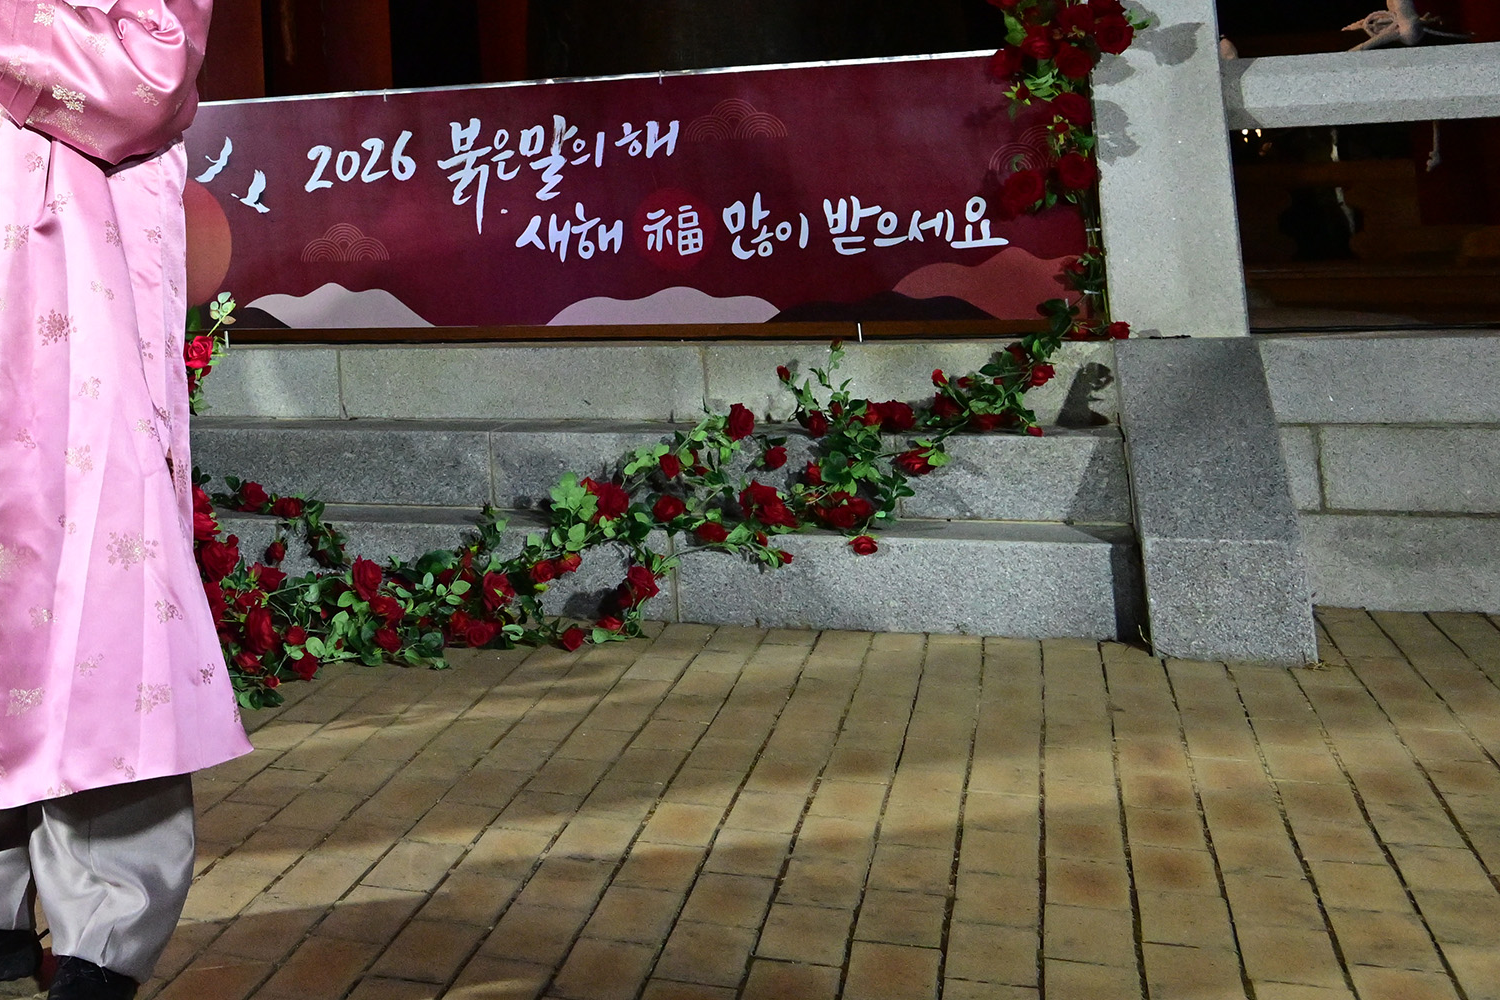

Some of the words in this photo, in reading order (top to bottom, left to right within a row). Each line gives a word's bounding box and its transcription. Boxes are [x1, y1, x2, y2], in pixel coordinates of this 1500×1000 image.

[304, 130, 417, 193] 2026
[515, 202, 624, 262] 새해
[642, 204, 703, 256] 福
[722, 191, 809, 260] 많이
[822, 195, 1010, 256] 받으세요
